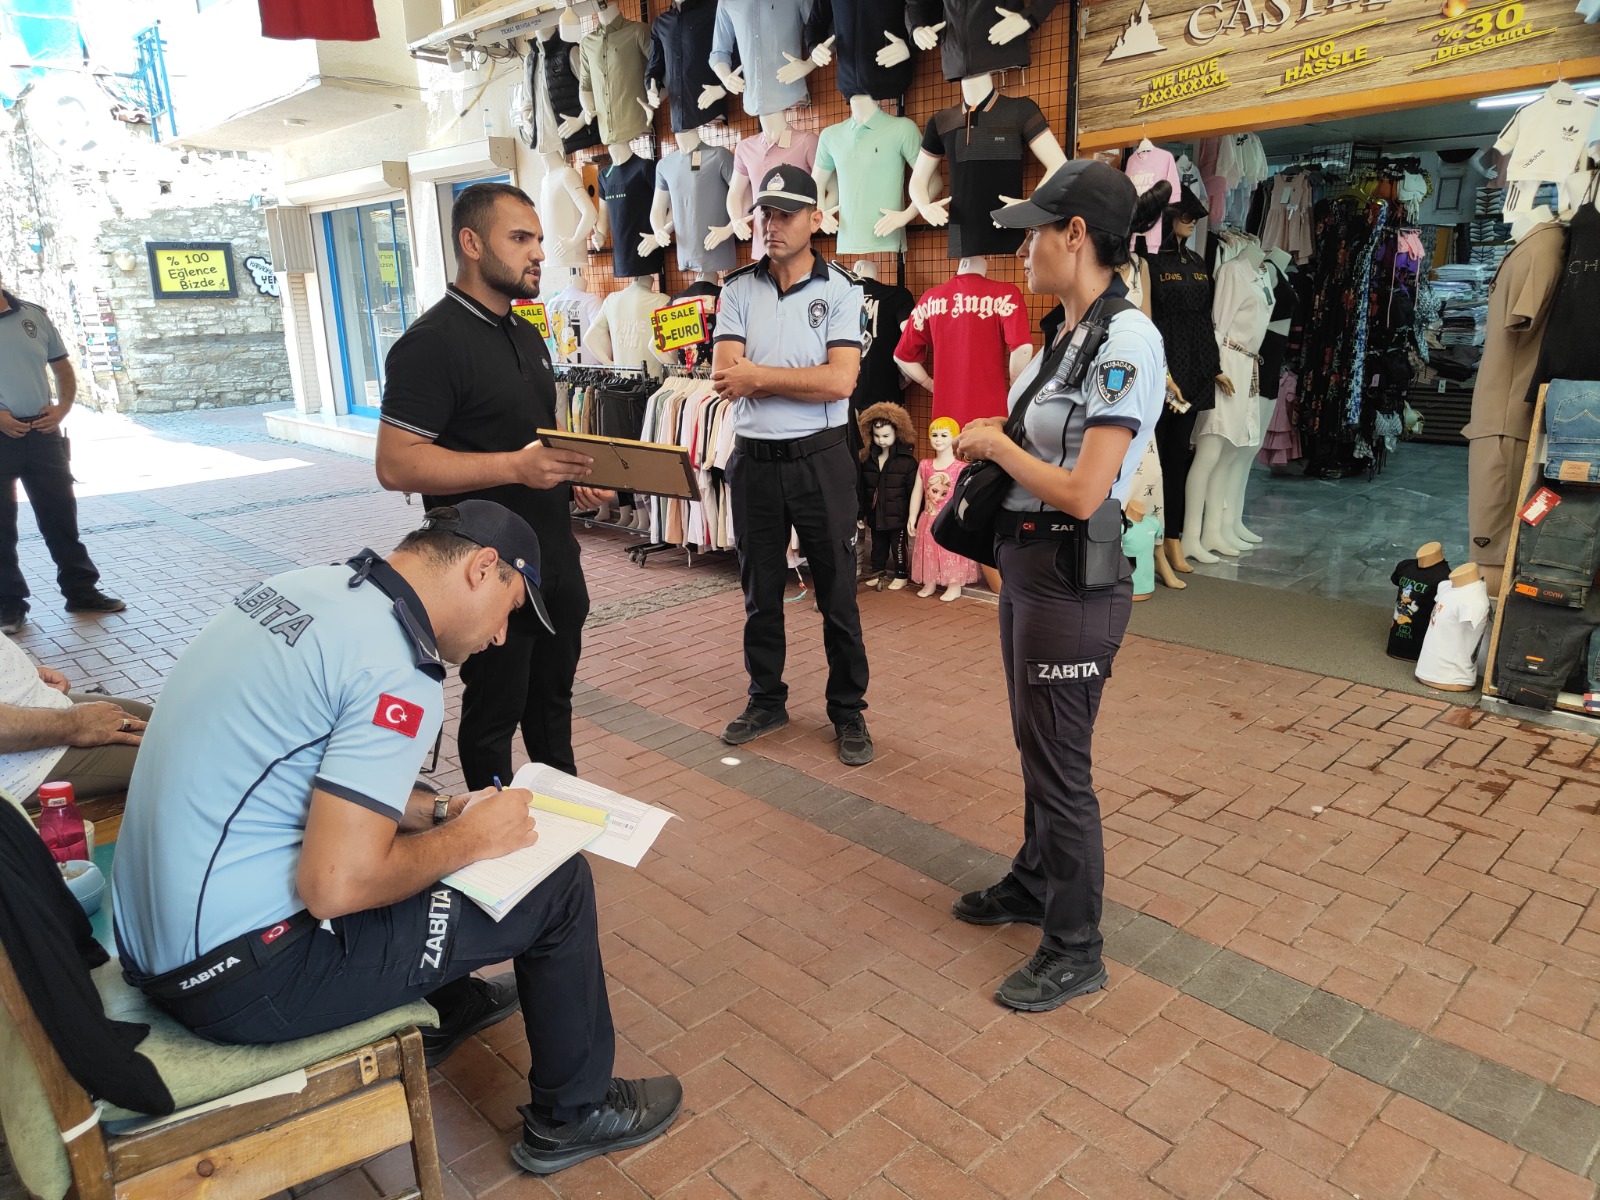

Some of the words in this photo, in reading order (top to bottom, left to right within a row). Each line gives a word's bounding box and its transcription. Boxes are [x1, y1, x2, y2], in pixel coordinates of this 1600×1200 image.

[1304, 40, 1336, 62] NO
[1437, 21, 1534, 60] Discount
[1151, 72, 1175, 90] WE
[1178, 57, 1219, 82] HAVE
[1285, 44, 1369, 82] HASSLE
[166, 256, 180, 266] %
[184, 252, 210, 264] 100
[168, 266, 218, 281] Eğlence
[179, 277, 216, 290] Bizde
[520, 308, 543, 317] SALE
[670, 306, 695, 321] SALE
[950, 292, 1018, 320] Angels
[1037, 661, 1100, 681] ZABITA
[419, 888, 452, 969] ZABITA
[179, 956, 241, 990] ZABITA
